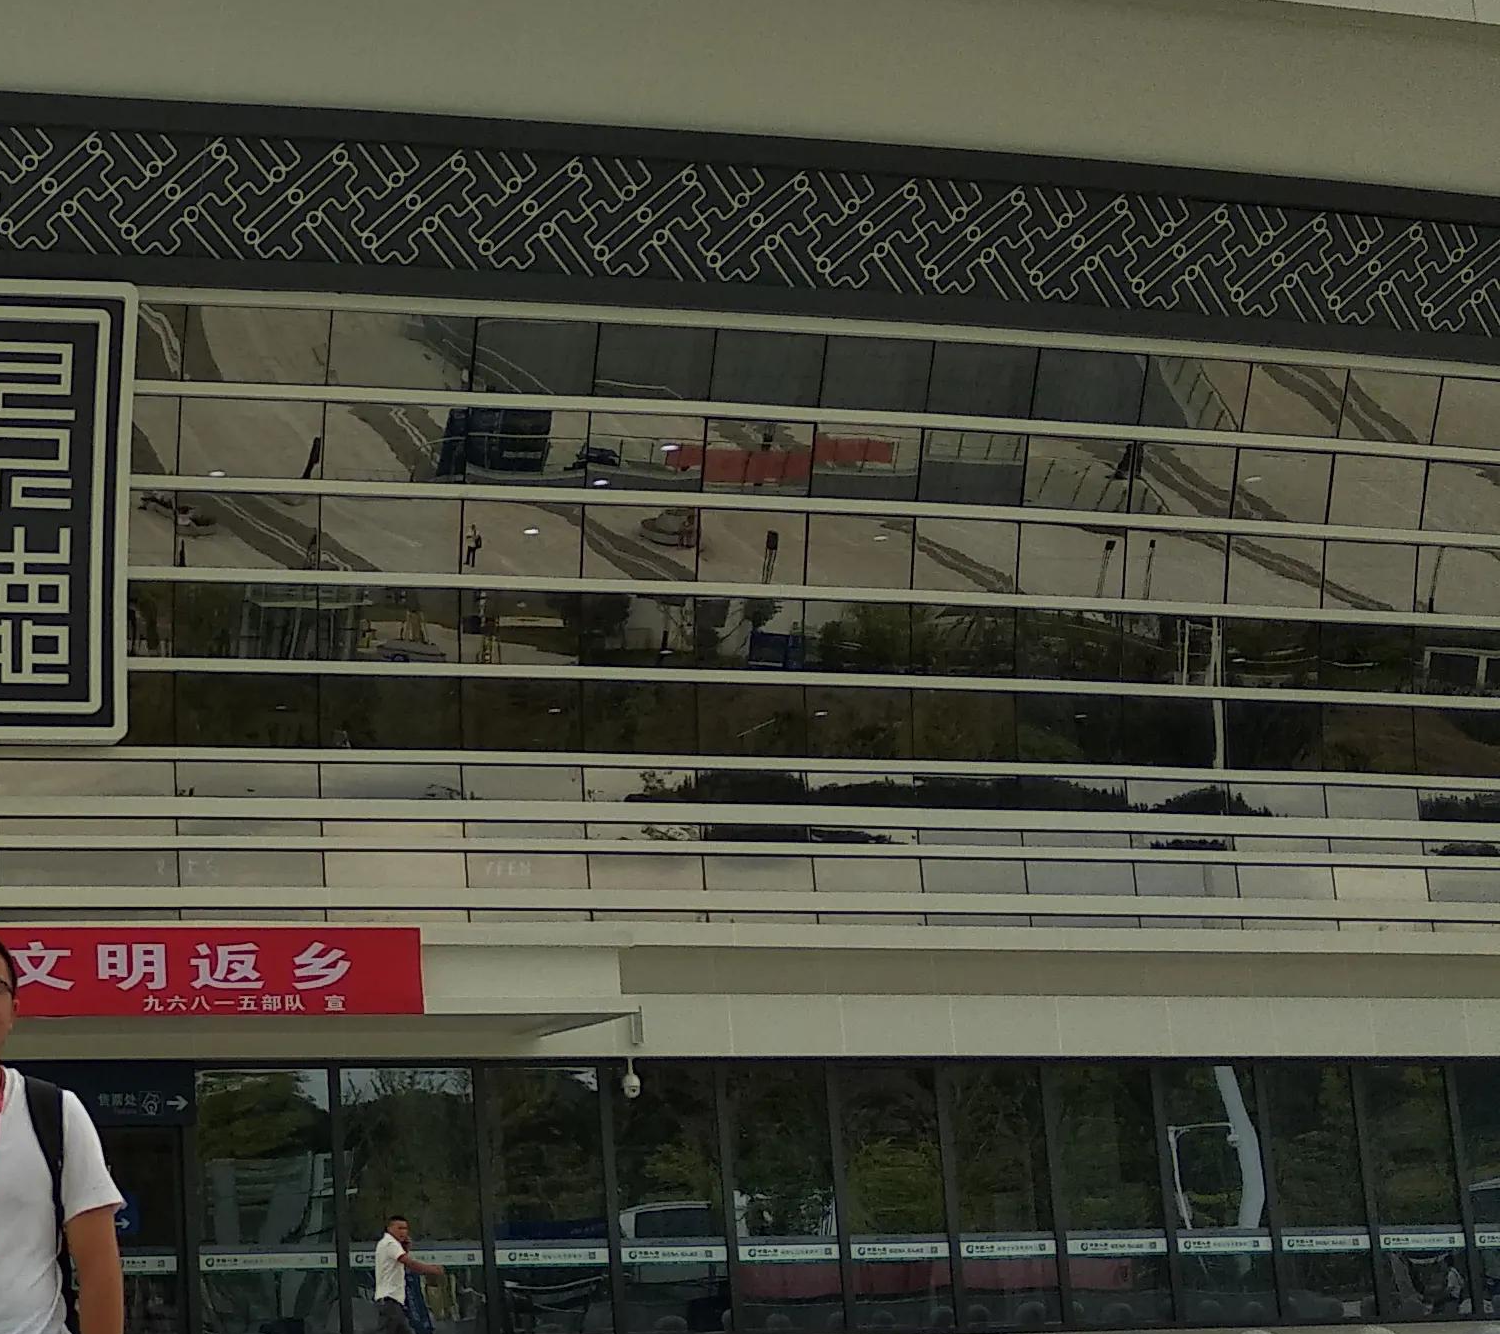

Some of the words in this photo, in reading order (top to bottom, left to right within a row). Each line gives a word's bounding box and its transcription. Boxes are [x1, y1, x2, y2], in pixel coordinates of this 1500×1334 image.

[11, 940, 352, 992] 文明返乡
[142, 993, 307, 1012] 九六八一五部队
[323, 994, 347, 1012] 宣
